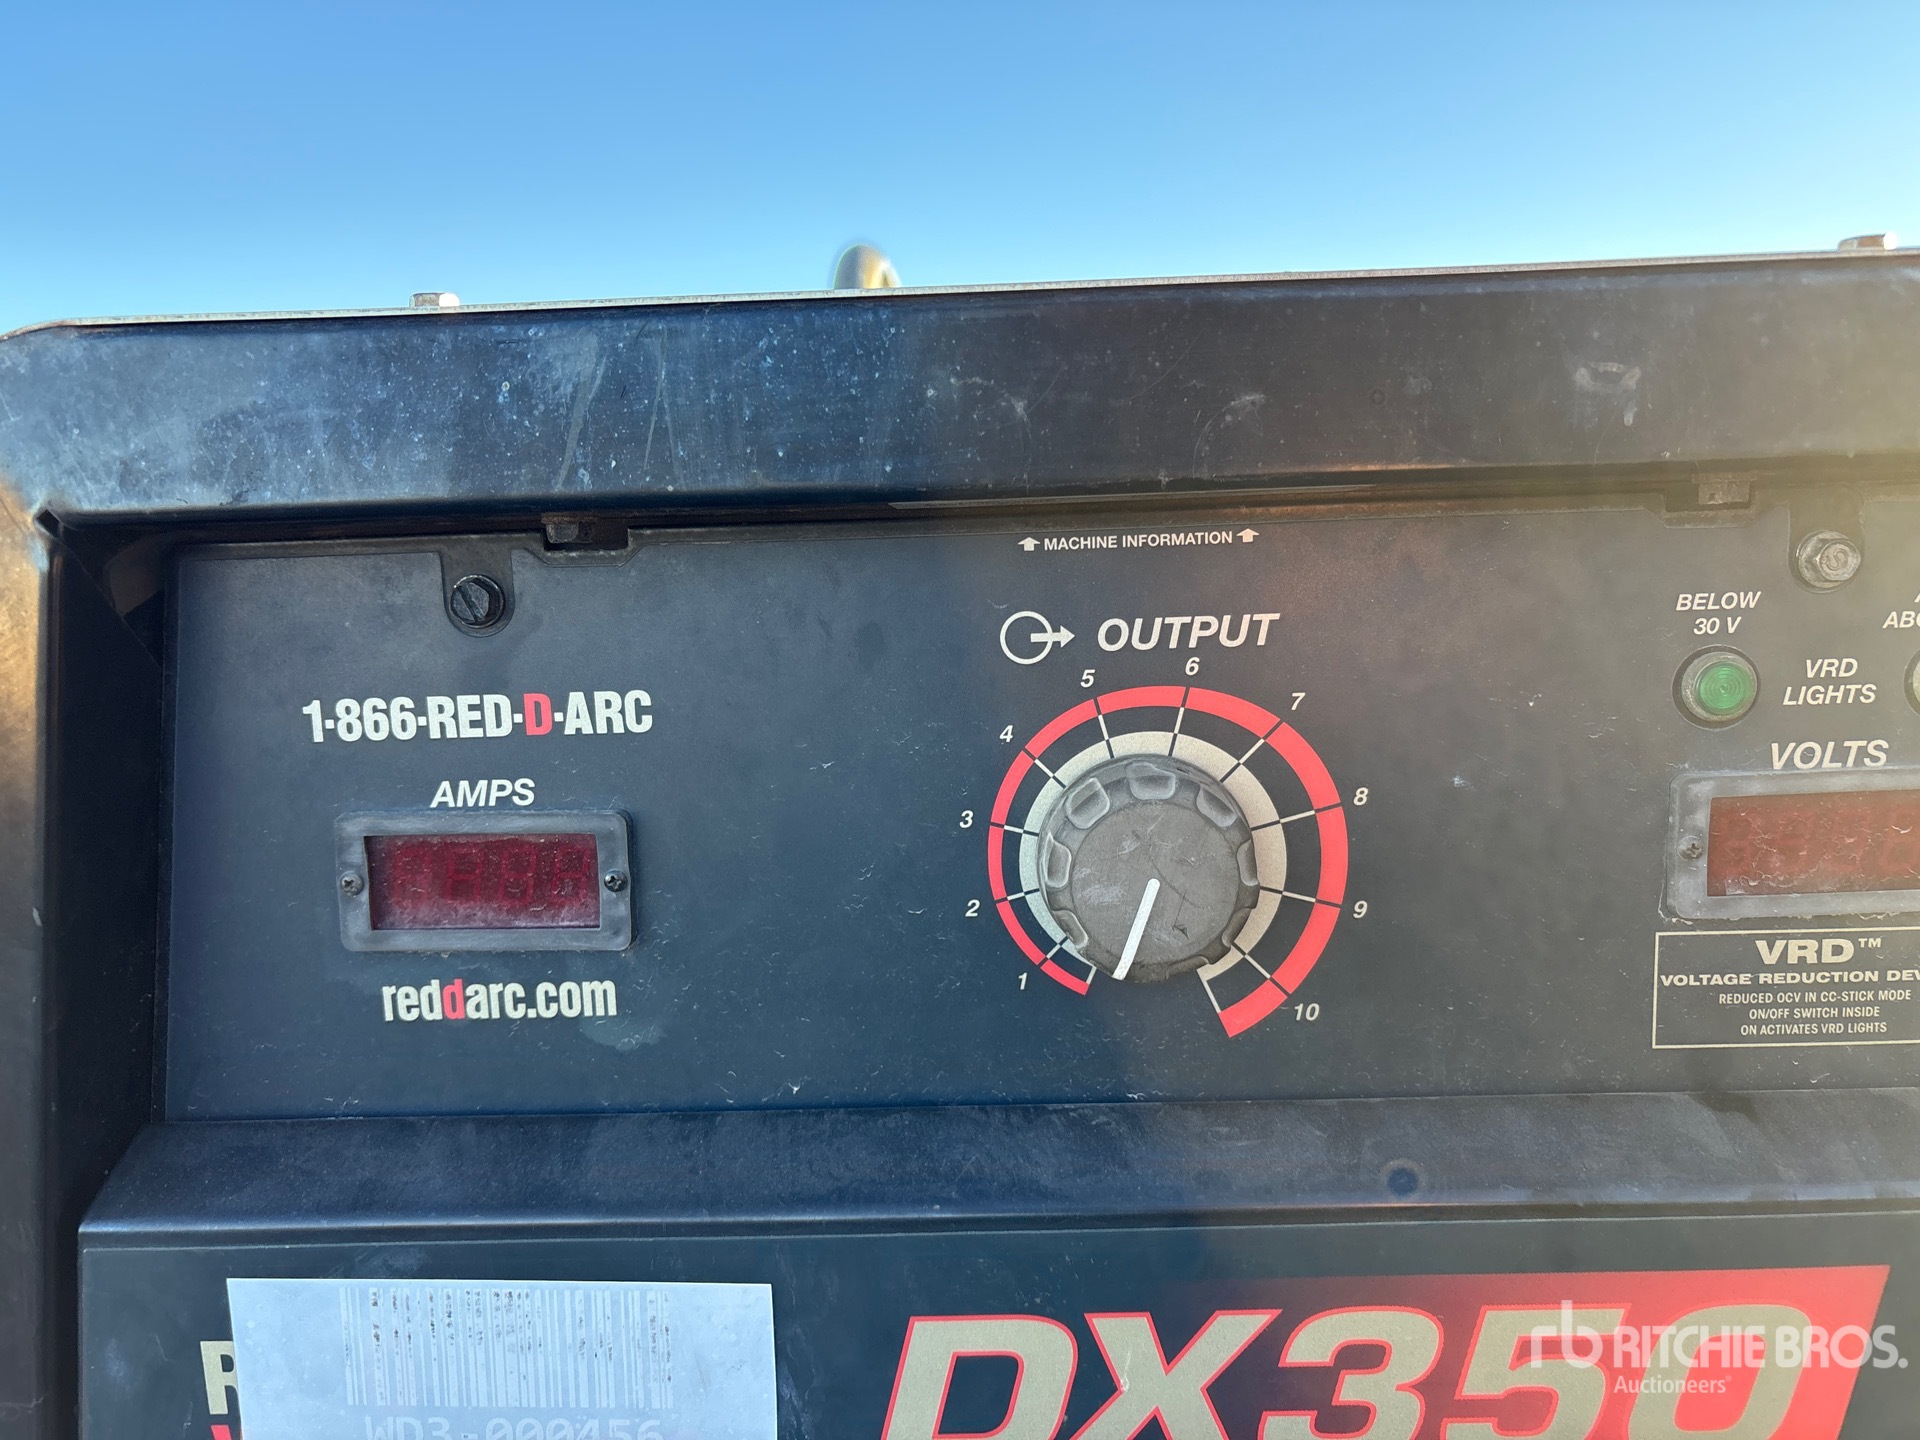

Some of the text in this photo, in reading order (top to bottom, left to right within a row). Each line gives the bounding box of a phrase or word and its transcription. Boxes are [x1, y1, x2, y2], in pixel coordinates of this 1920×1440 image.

[1044, 531, 1233, 551] MACHINE INFORMATION
[1675, 591, 1762, 612] BELOW
[1693, 616, 1742, 635] 30 V
[1882, 610, 1920, 629] AB
[1097, 613, 1281, 652] OUTPUT
[1185, 657, 1200, 676] 6
[1805, 658, 1858, 679] VRD
[1080, 668, 1096, 688] 5
[1290, 692, 1305, 711] 7
[1782, 684, 1877, 706] LIGHTS
[302, 690, 653, 743] 1-866-RED-D-ARC
[999, 725, 1014, 743] 4
[1770, 739, 1890, 770] VOLTS
[430, 778, 535, 808] AMPS
[1353, 787, 1368, 806] 8
[959, 811, 974, 829] 3
[965, 900, 980, 918] 2
[1353, 901, 1368, 919] 9
[1018, 972, 1028, 990] 1
[1660, 973, 1752, 987] VOLTAGE
[1758, 970, 1879, 985] REDUCTION
[382, 978, 617, 1023] reddarc.com
[1719, 989, 1912, 1005] REDUCED OCV IN CC-STICK MODE
[1294, 1003, 1320, 1021] 10
[1748, 1006, 1880, 1020] ON/OFF SWITCH INSIDE
[1740, 1021, 1888, 1036] ON ACTIVATES VRD LIGHTS
[884, 1303, 1814, 1440] DX350
